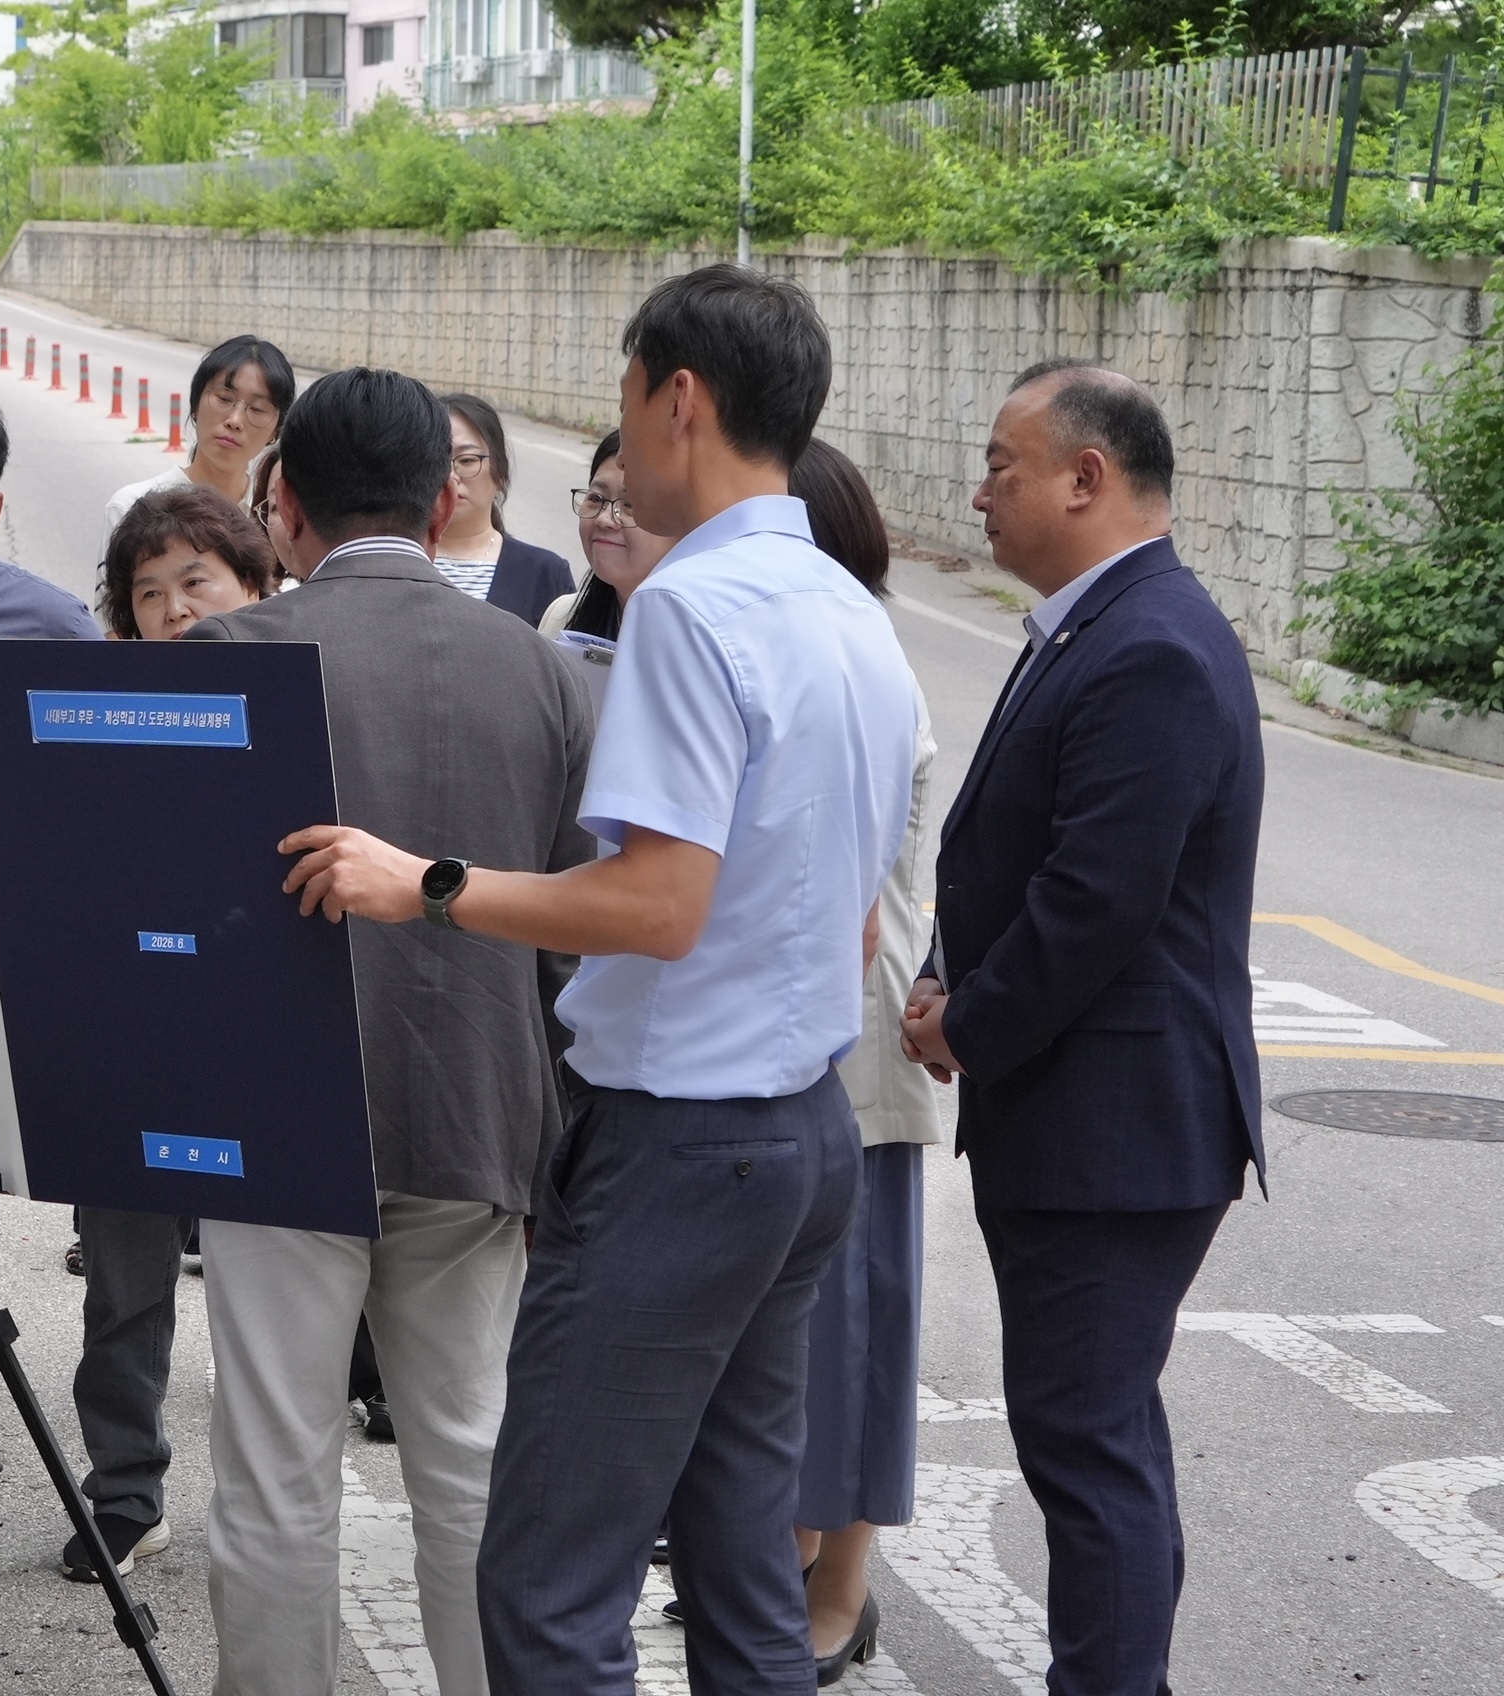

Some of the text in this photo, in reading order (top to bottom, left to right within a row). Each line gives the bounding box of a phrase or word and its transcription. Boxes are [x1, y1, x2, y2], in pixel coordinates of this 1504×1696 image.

[44, 708, 76, 725] 사대부고
[78, 709, 94, 725] 후문
[104, 710, 136, 726] 계성학교
[138, 711, 147, 726] 간
[149, 711, 180, 727] 도로정비
[183, 712, 231, 729] 실시설계용역
